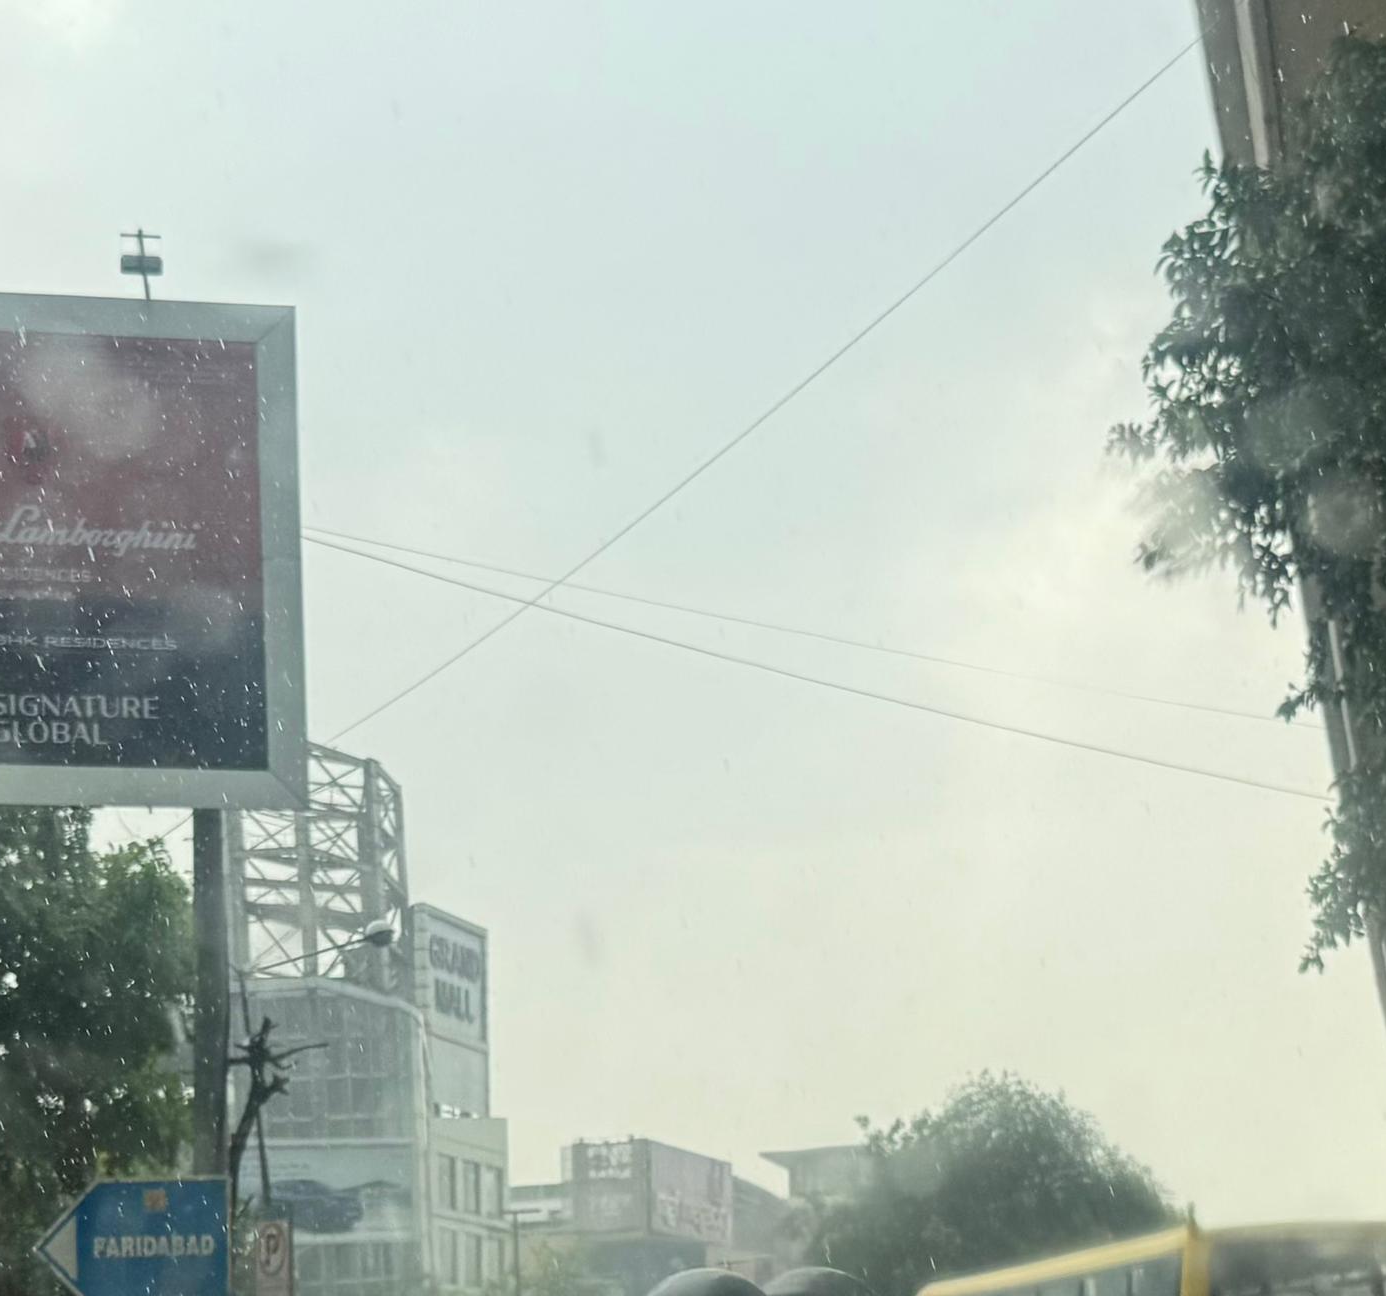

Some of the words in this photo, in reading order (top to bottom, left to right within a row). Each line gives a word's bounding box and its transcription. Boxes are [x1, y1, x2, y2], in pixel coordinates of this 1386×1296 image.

[45, 636, 177, 651] RESIDENCES
[429, 934, 480, 983] GRAND
[434, 978, 475, 1024] MALL
[93, 1234, 215, 1258] FARIDABAD
